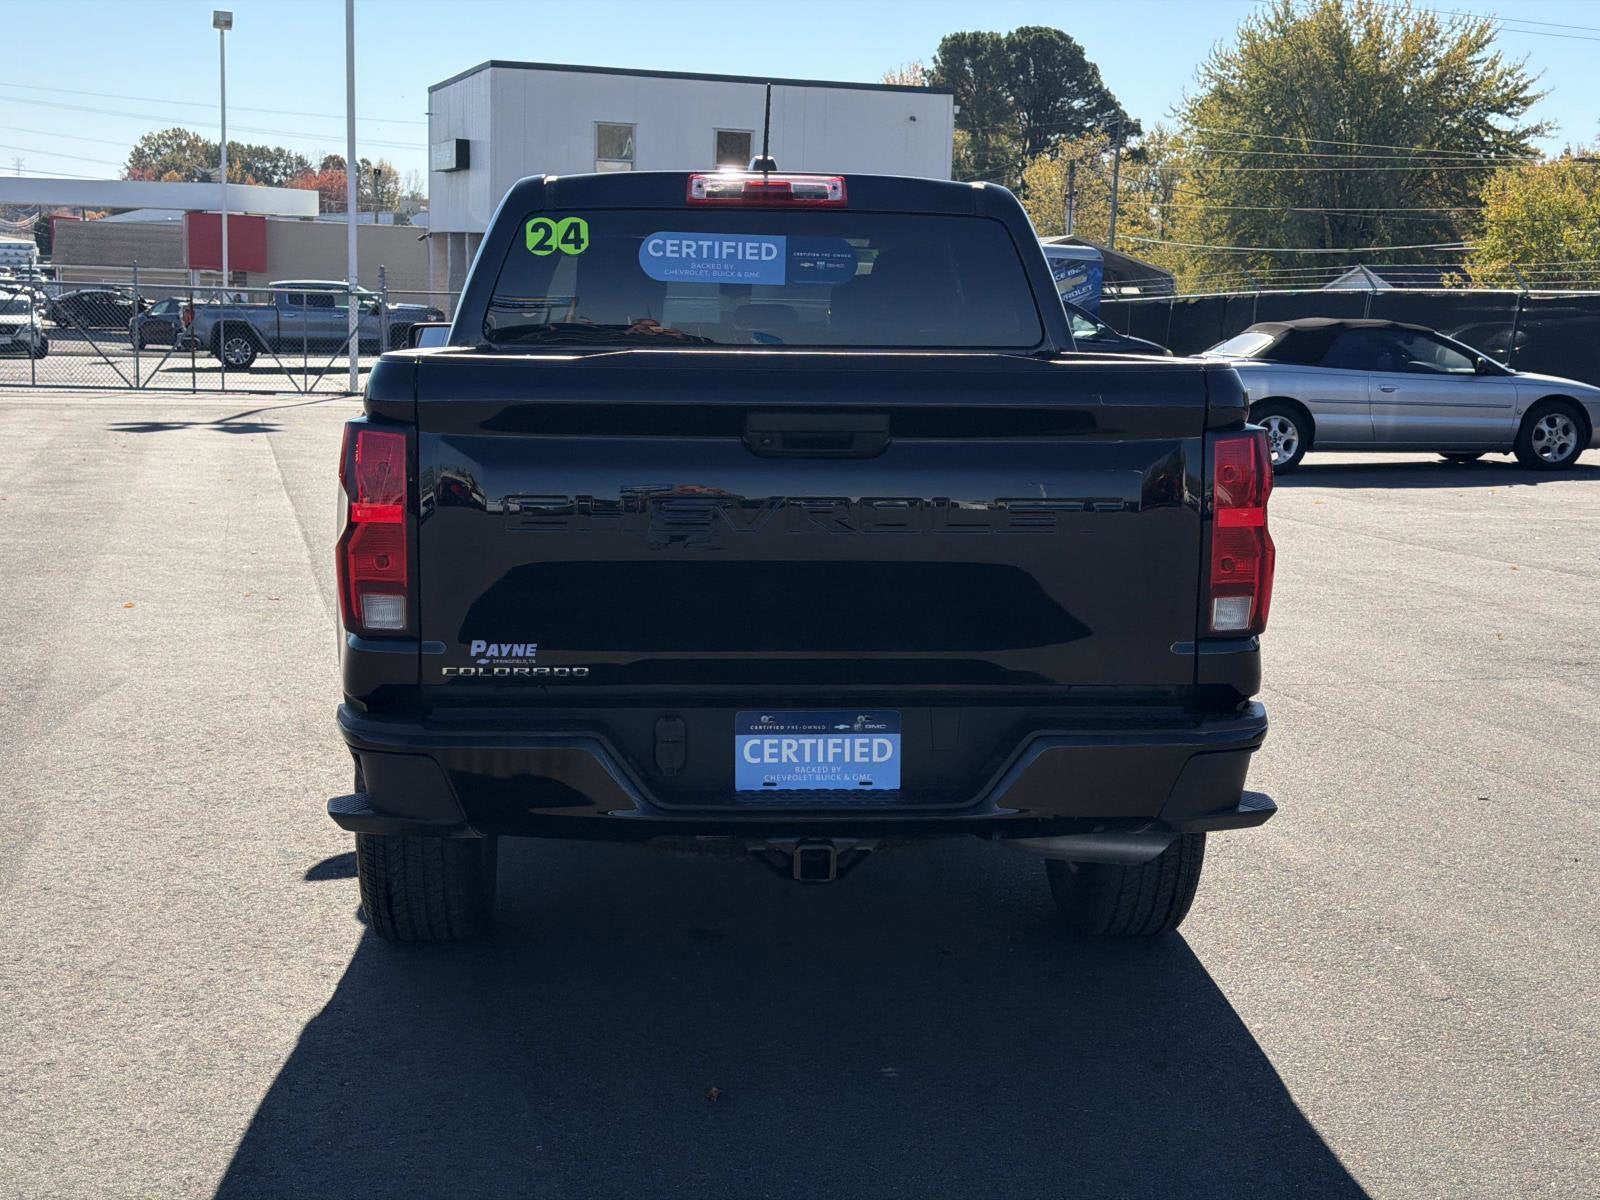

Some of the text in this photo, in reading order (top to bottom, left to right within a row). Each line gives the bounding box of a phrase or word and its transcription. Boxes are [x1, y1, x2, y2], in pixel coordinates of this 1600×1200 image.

[530, 221, 585, 252] 24
[647, 238, 778, 261] CERTIFIED
[690, 262, 722, 270] BACKED
[712, 270, 737, 278] BUICK
[441, 667, 590, 677] COLORADO
[743, 738, 893, 764] CERTIFIED
[795, 766, 842, 774] BACKED BY
[852, 773, 873, 781] GMC
